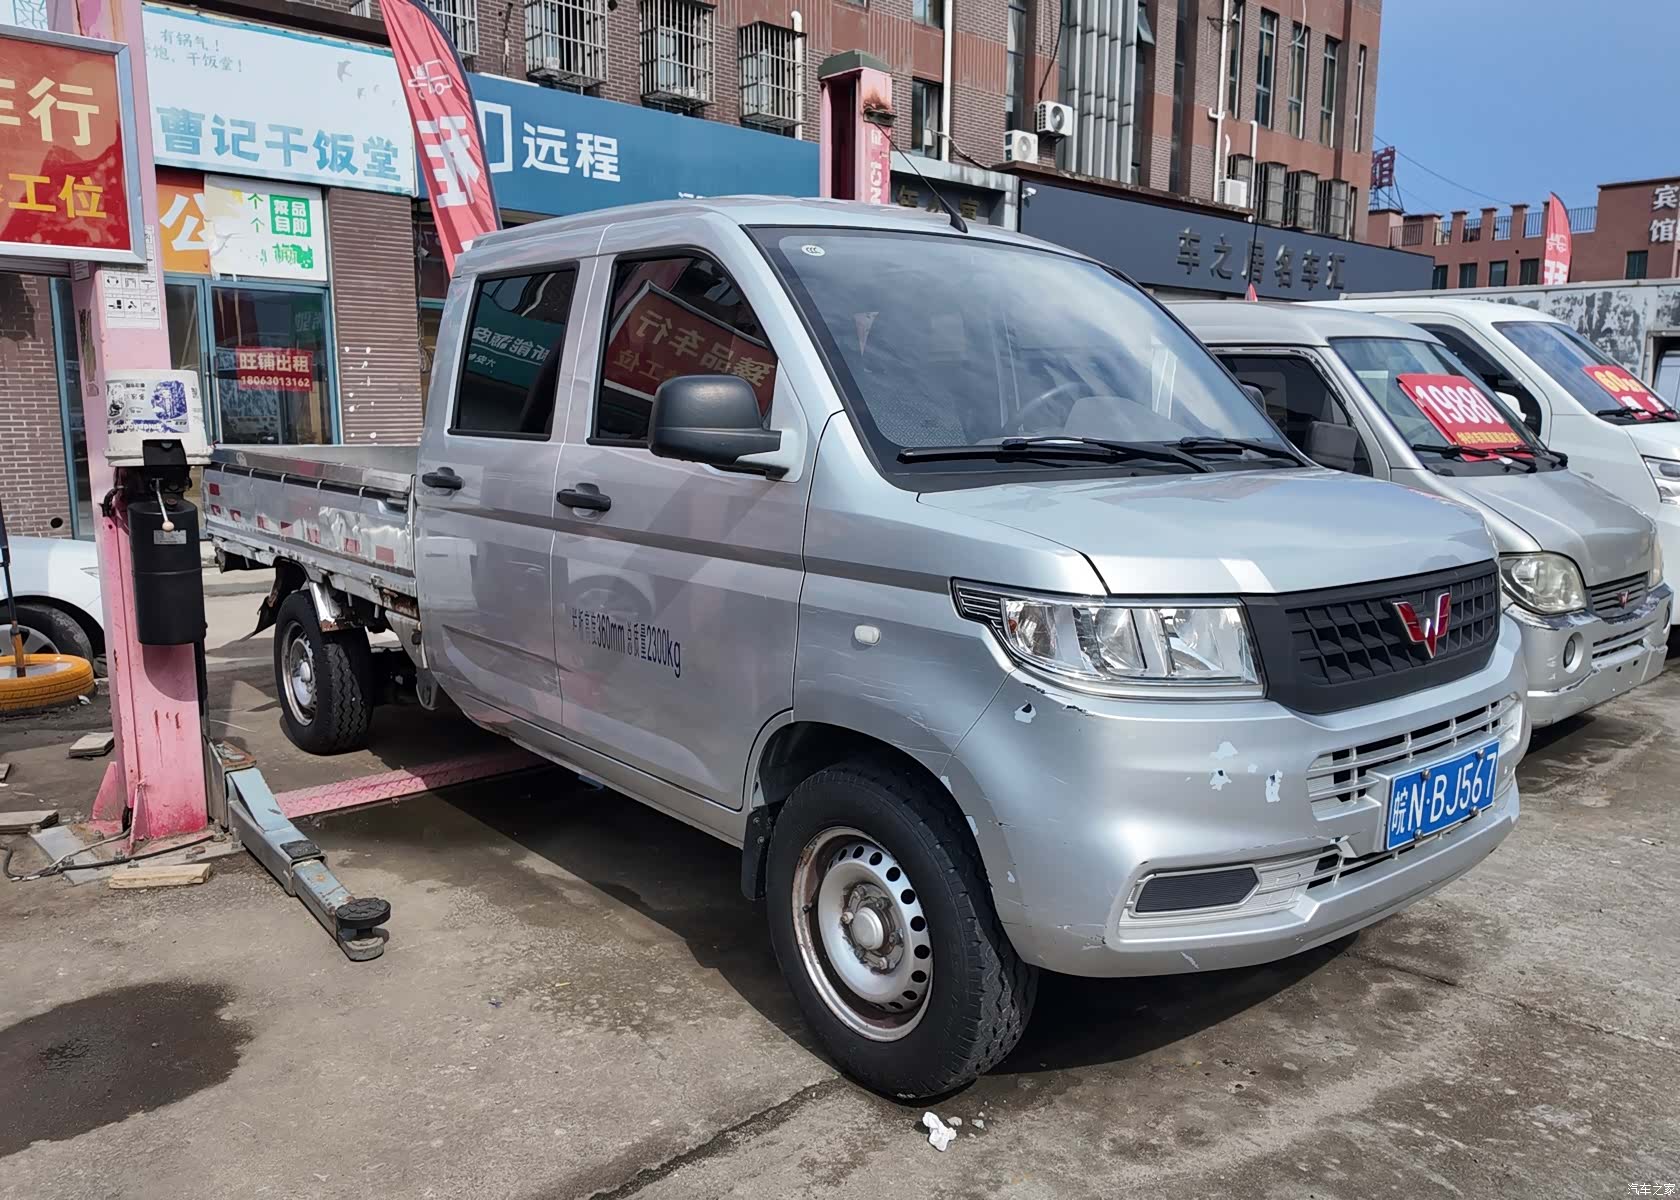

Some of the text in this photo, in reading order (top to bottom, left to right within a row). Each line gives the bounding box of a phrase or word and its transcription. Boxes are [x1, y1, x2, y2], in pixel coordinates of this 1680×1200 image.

[155, 105, 401, 181] 曹记干饭堂
[523, 123, 621, 183] 远程
[0, 173, 107, 218] 工位
[239, 351, 311, 373] 旺铺出租
[241, 375, 311, 388] 18063013162
[1415, 385, 1505, 425] 19880
